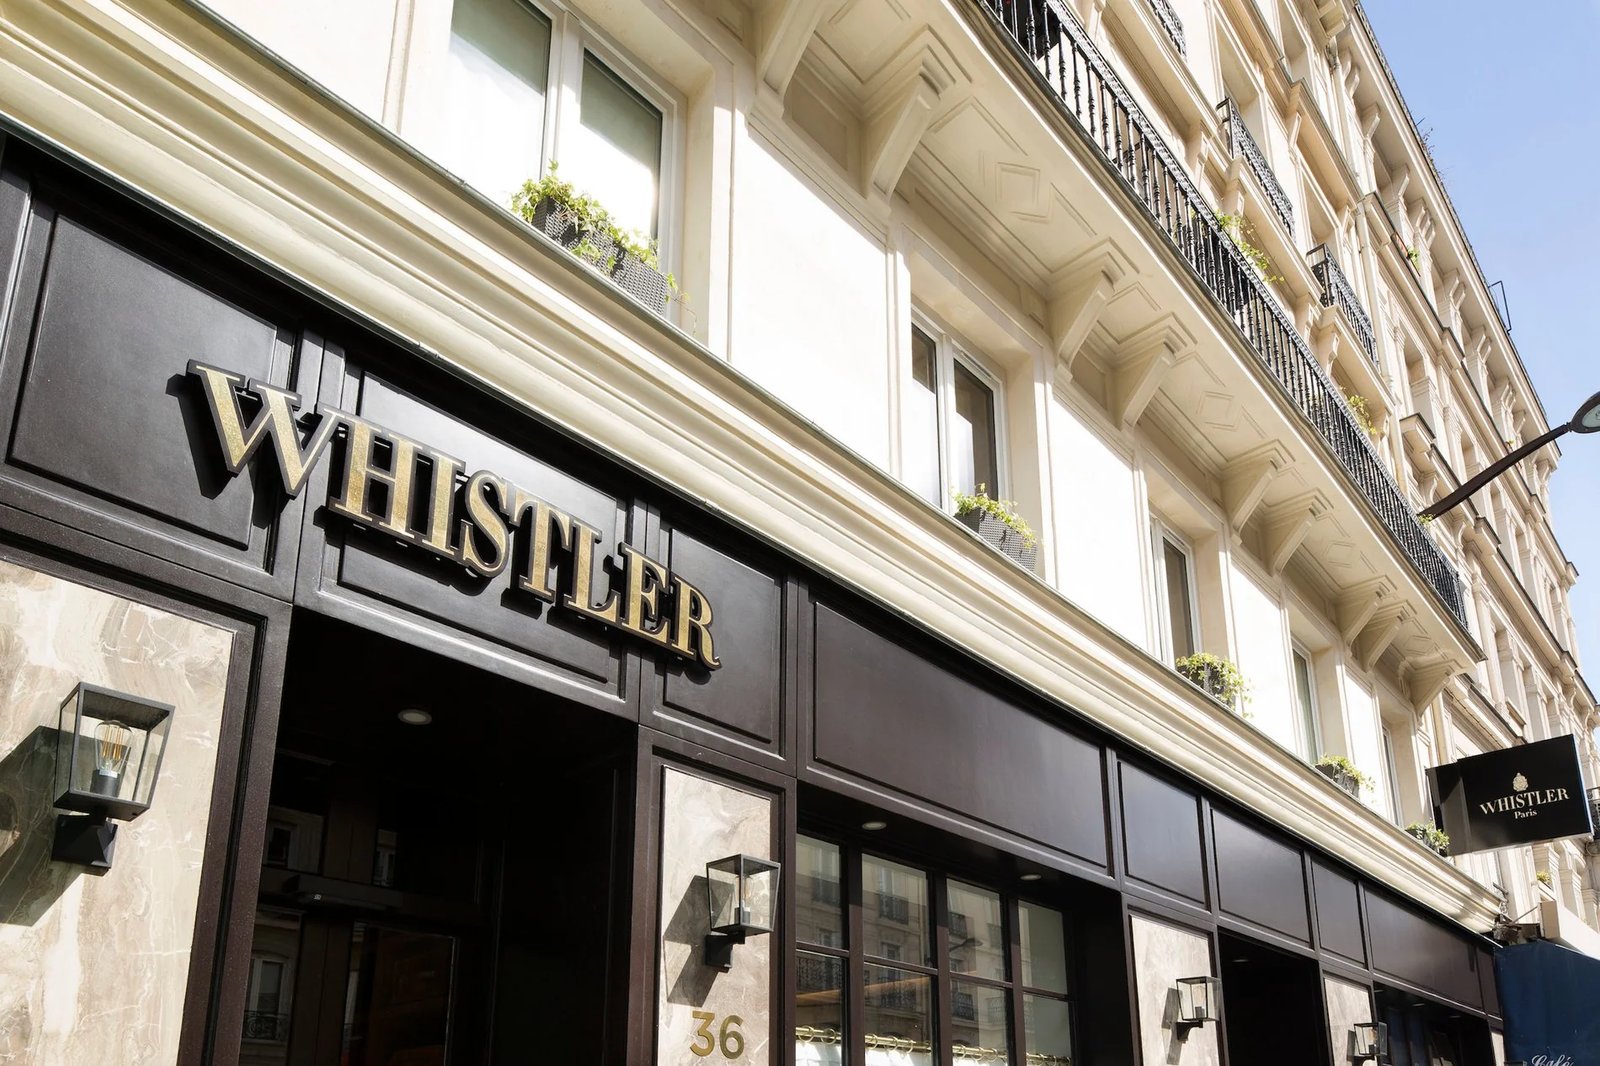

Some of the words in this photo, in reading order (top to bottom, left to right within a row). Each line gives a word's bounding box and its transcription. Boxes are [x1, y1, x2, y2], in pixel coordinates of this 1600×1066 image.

[188, 359, 722, 670] WHISTLER
[1480, 788, 1569, 815] WHISTLER
[1514, 808, 1538, 819] Paris
[690, 1010, 745, 1060] 36
